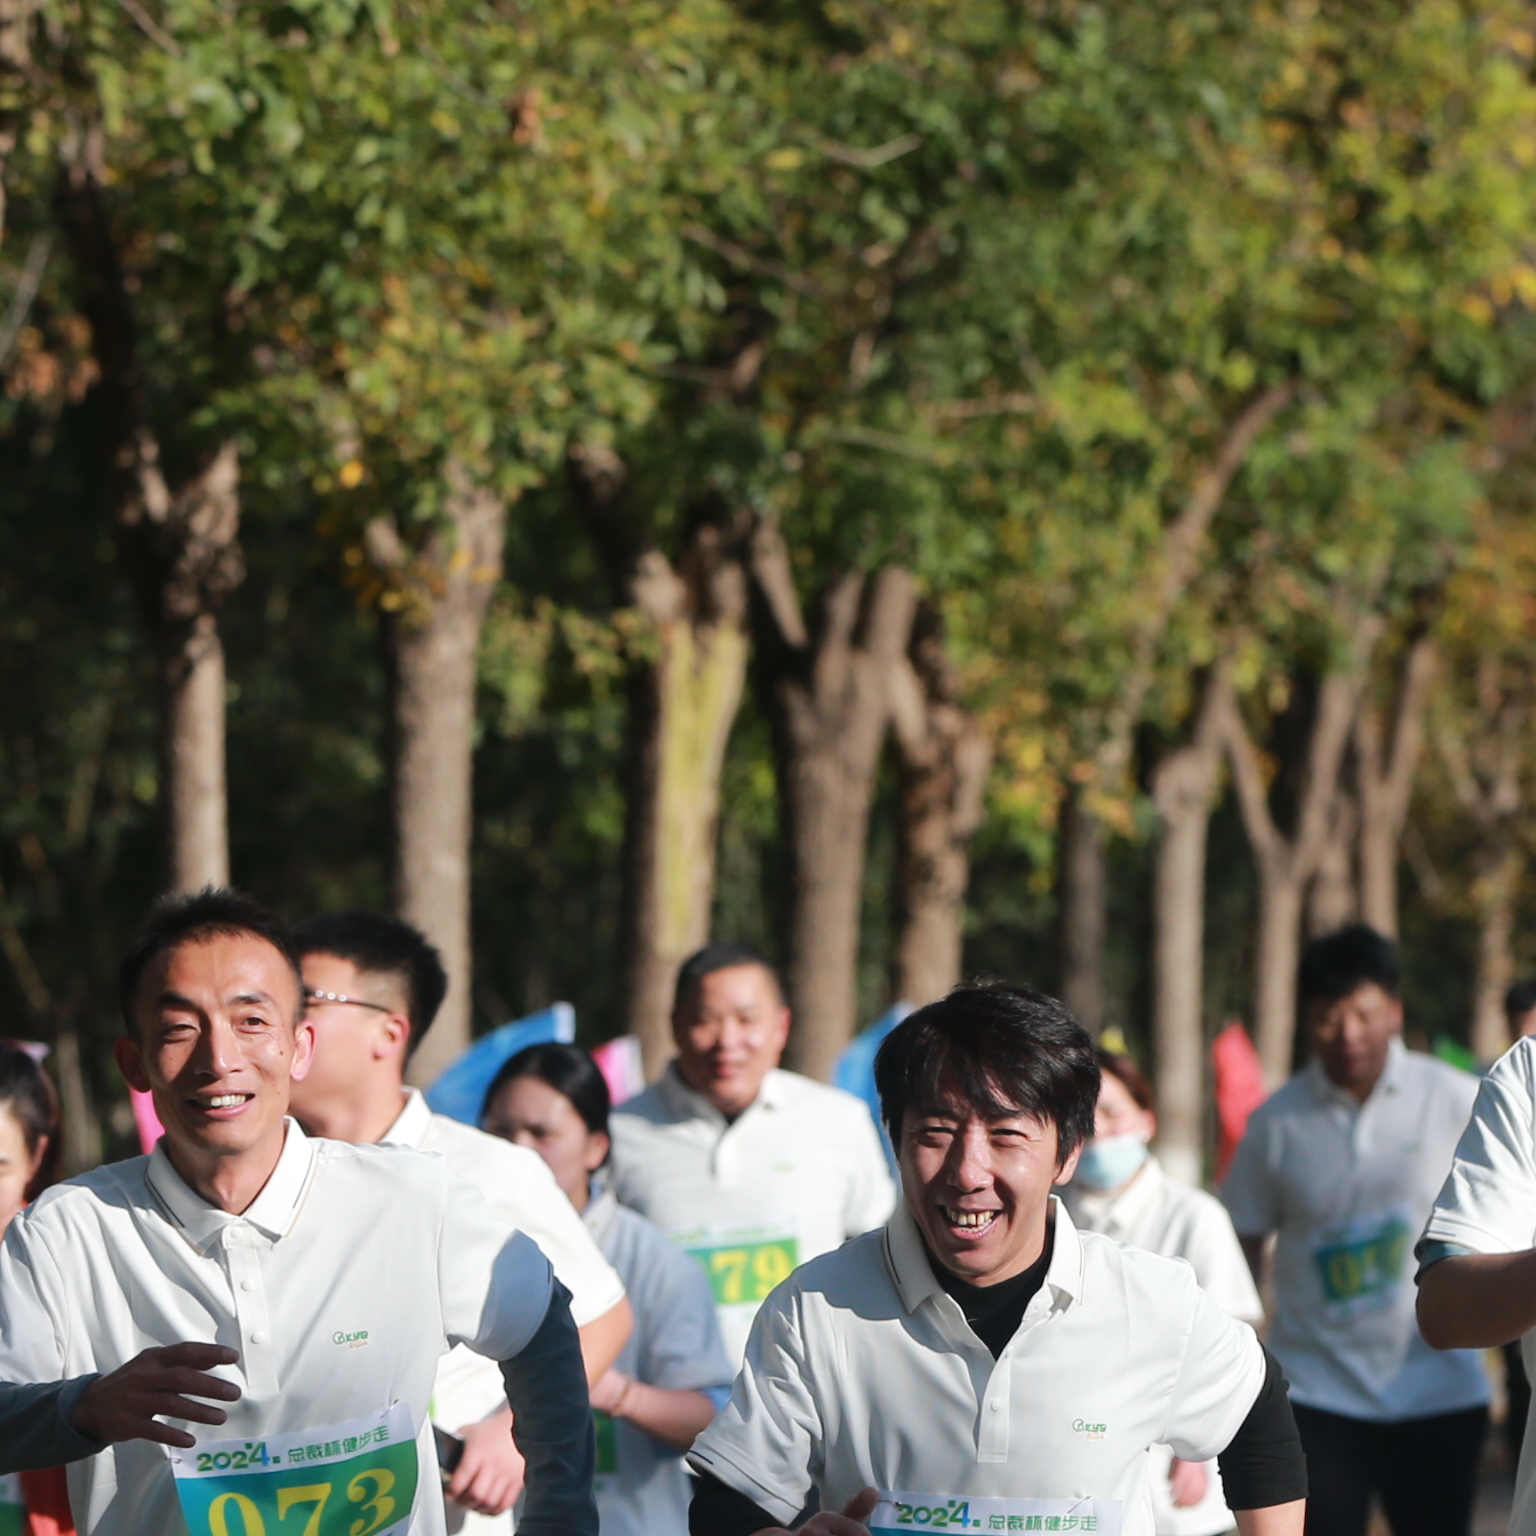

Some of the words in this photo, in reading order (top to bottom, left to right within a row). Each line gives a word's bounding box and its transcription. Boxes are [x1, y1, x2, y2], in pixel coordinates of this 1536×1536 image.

[288, 1424, 390, 1463] 总裁杯健步走
[988, 1513, 1097, 1531] 总裁杯健步走
